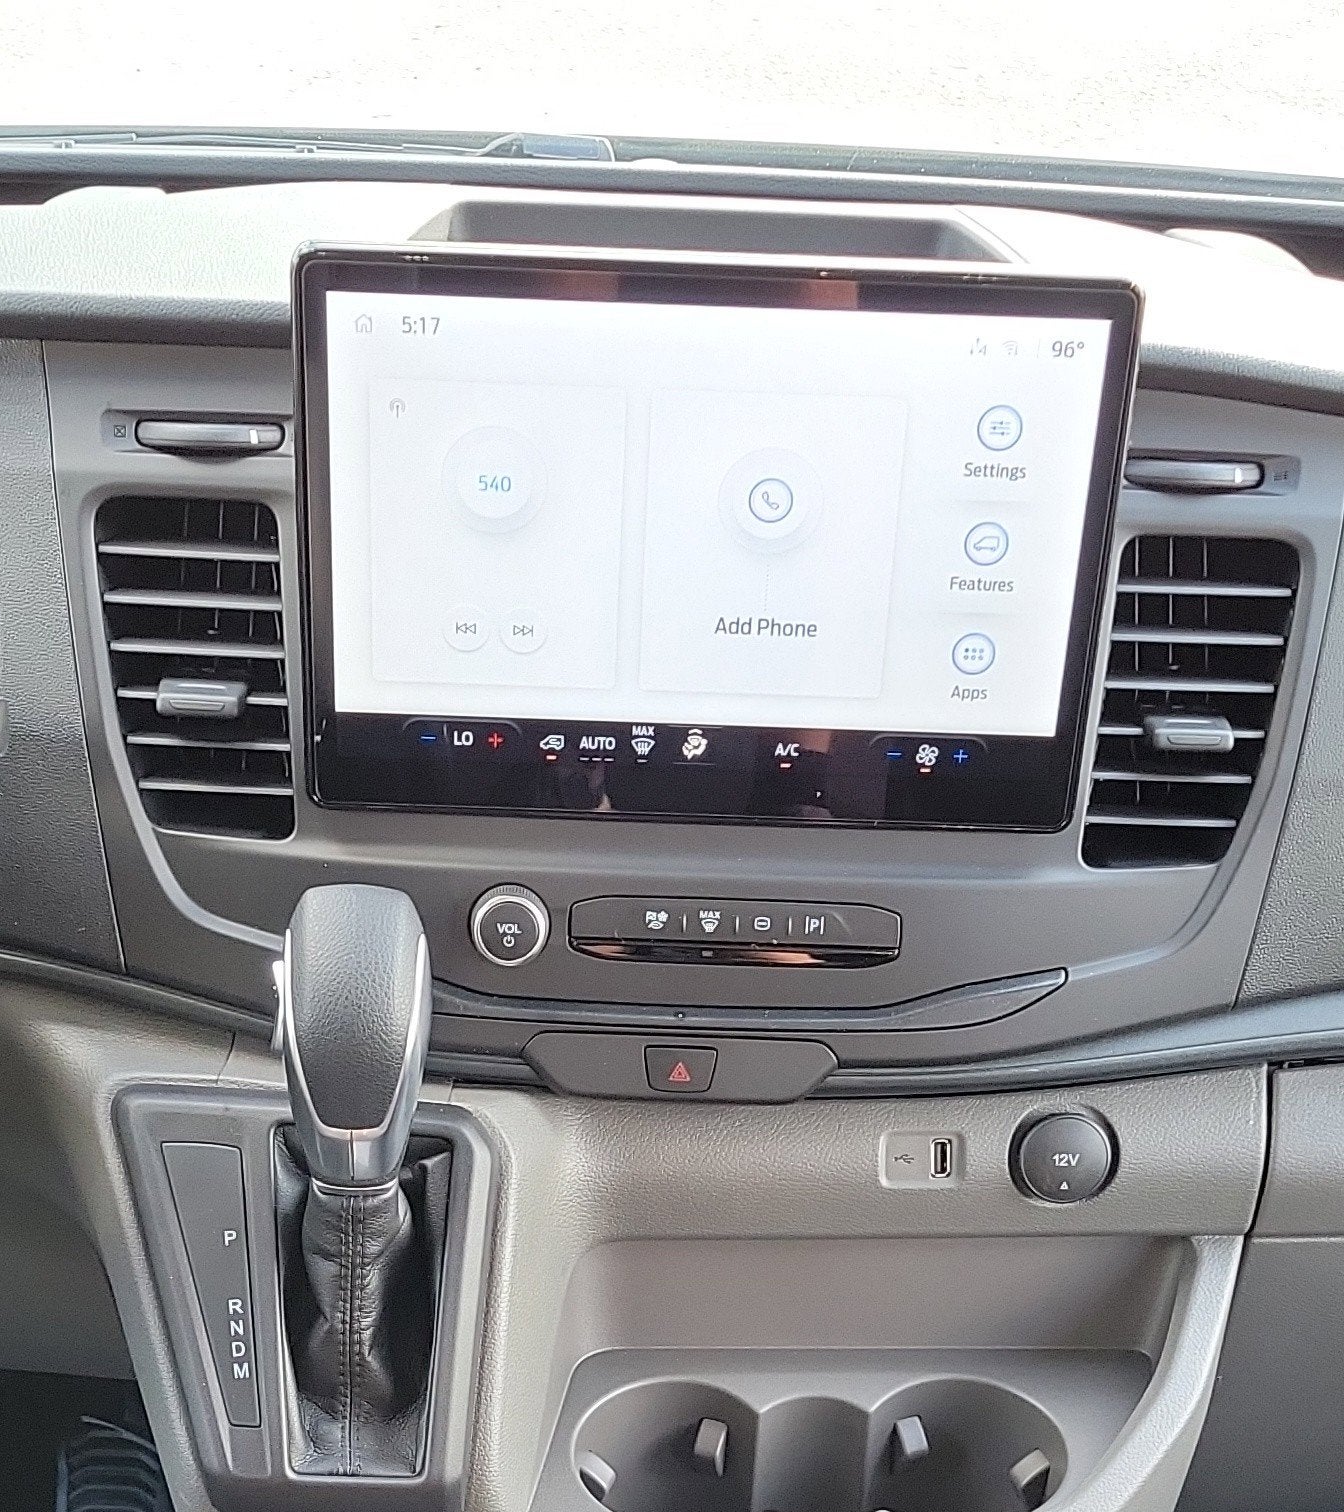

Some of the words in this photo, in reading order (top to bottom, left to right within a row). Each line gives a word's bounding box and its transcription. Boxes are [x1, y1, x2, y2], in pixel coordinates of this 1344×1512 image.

[402, 316, 441, 335] 5:17
[1052, 341, 1085, 358] 96°
[963, 462, 1027, 481] Settings
[478, 475, 512, 492] 540
[949, 576, 1014, 592] Features
[714, 617, 752, 635] Add
[757, 618, 817, 637] Phone
[950, 685, 988, 702] Apps
[453, 731, 474, 746] LO
[632, 725, 654, 736] MAX
[579, 736, 616, 750] AUTO
[774, 742, 800, 757] A/C
[699, 910, 721, 919] MAX
[497, 923, 522, 934] VOL
[1052, 1153, 1081, 1167] 12V
[224, 1230, 237, 1247] P
[228, 1298, 244, 1315] R
[230, 1320, 245, 1336] N
[232, 1342, 245, 1357] D
[233, 1363, 250, 1379] M
